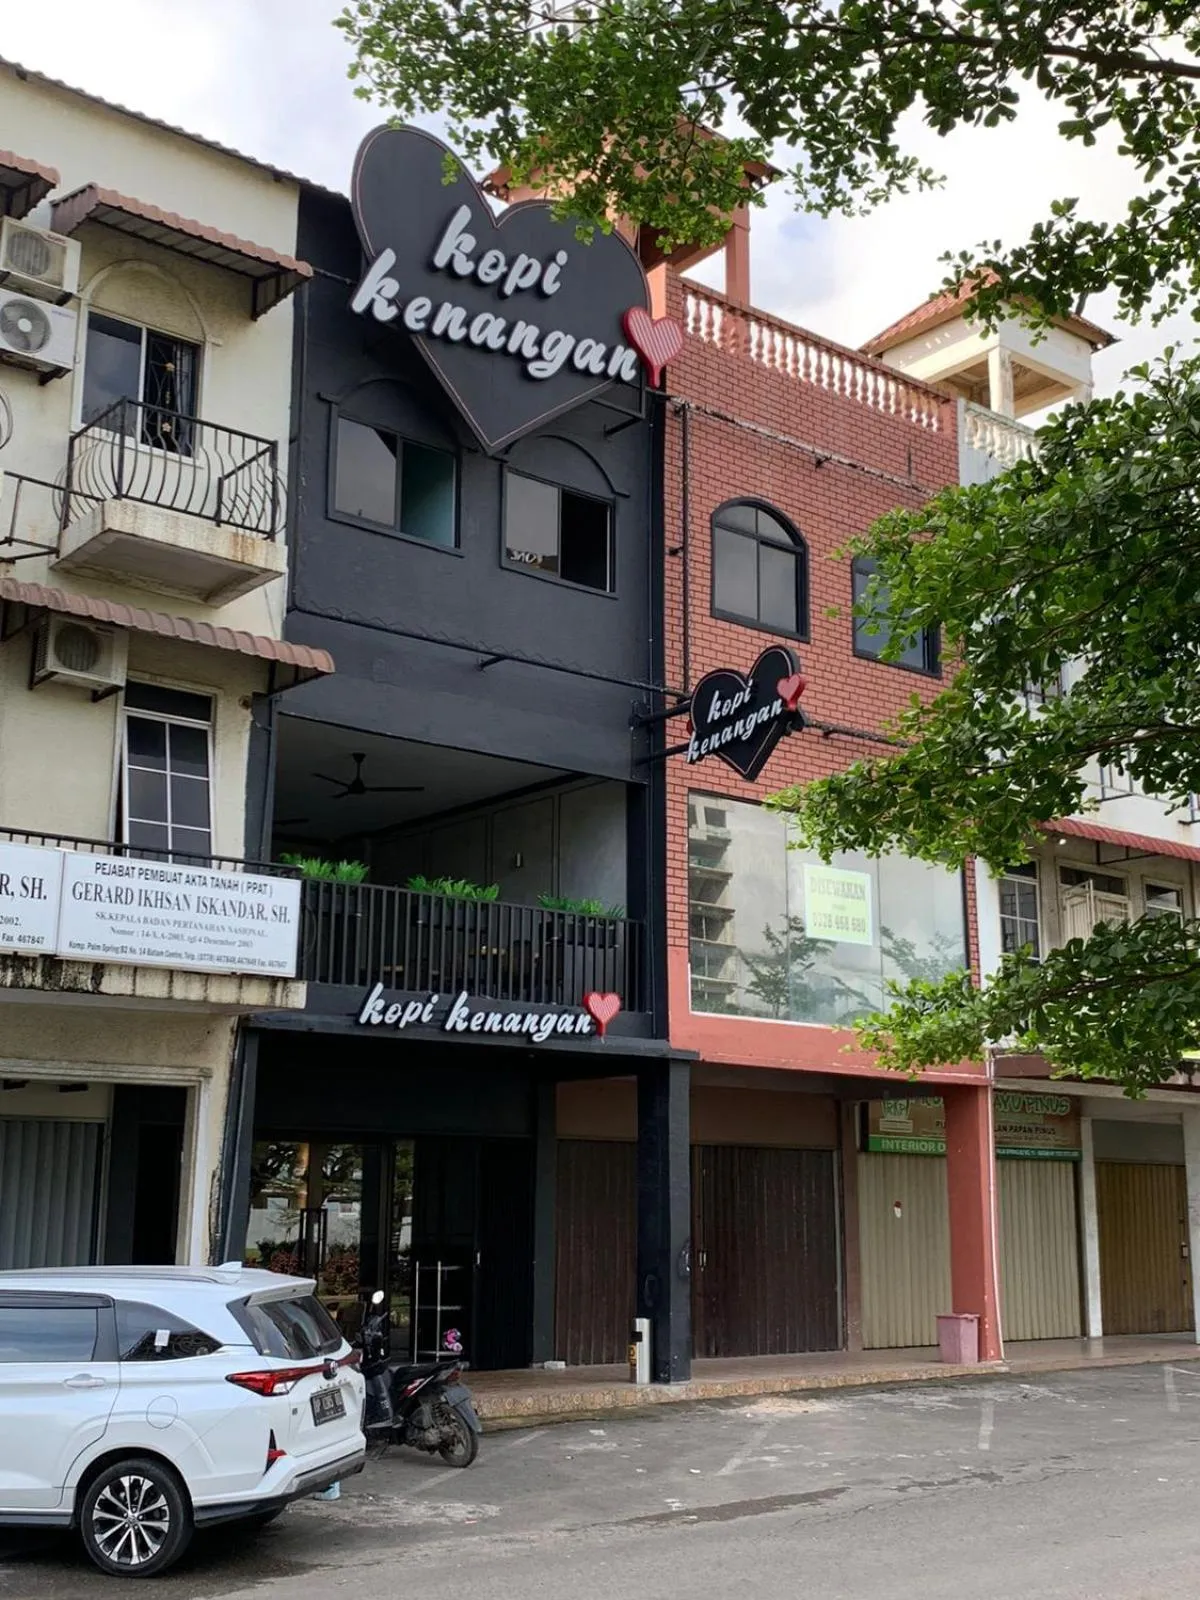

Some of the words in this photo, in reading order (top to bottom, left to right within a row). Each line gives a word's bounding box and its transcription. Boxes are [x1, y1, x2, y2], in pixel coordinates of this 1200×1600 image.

[433, 204, 568, 297] kopi
[351, 248, 638, 380] kenangan
[706, 679, 753, 723] kopi
[686, 699, 782, 763] kenangan
[20, 875, 47, 900] SH.
[72, 881, 134, 906] GERARD
[138, 888, 192, 911] IKHSAN
[196, 895, 268, 923] ISKANDAR,
[271, 904, 291, 924] SH.
[95, 862, 136, 879] PEJABAT
[138, 867, 183, 884] PEMBUAT
[185, 873, 208, 888] AKTA
[210, 876, 239, 892] TANAH
[358, 982, 439, 1028] kopi
[445, 990, 591, 1043] kenangan
